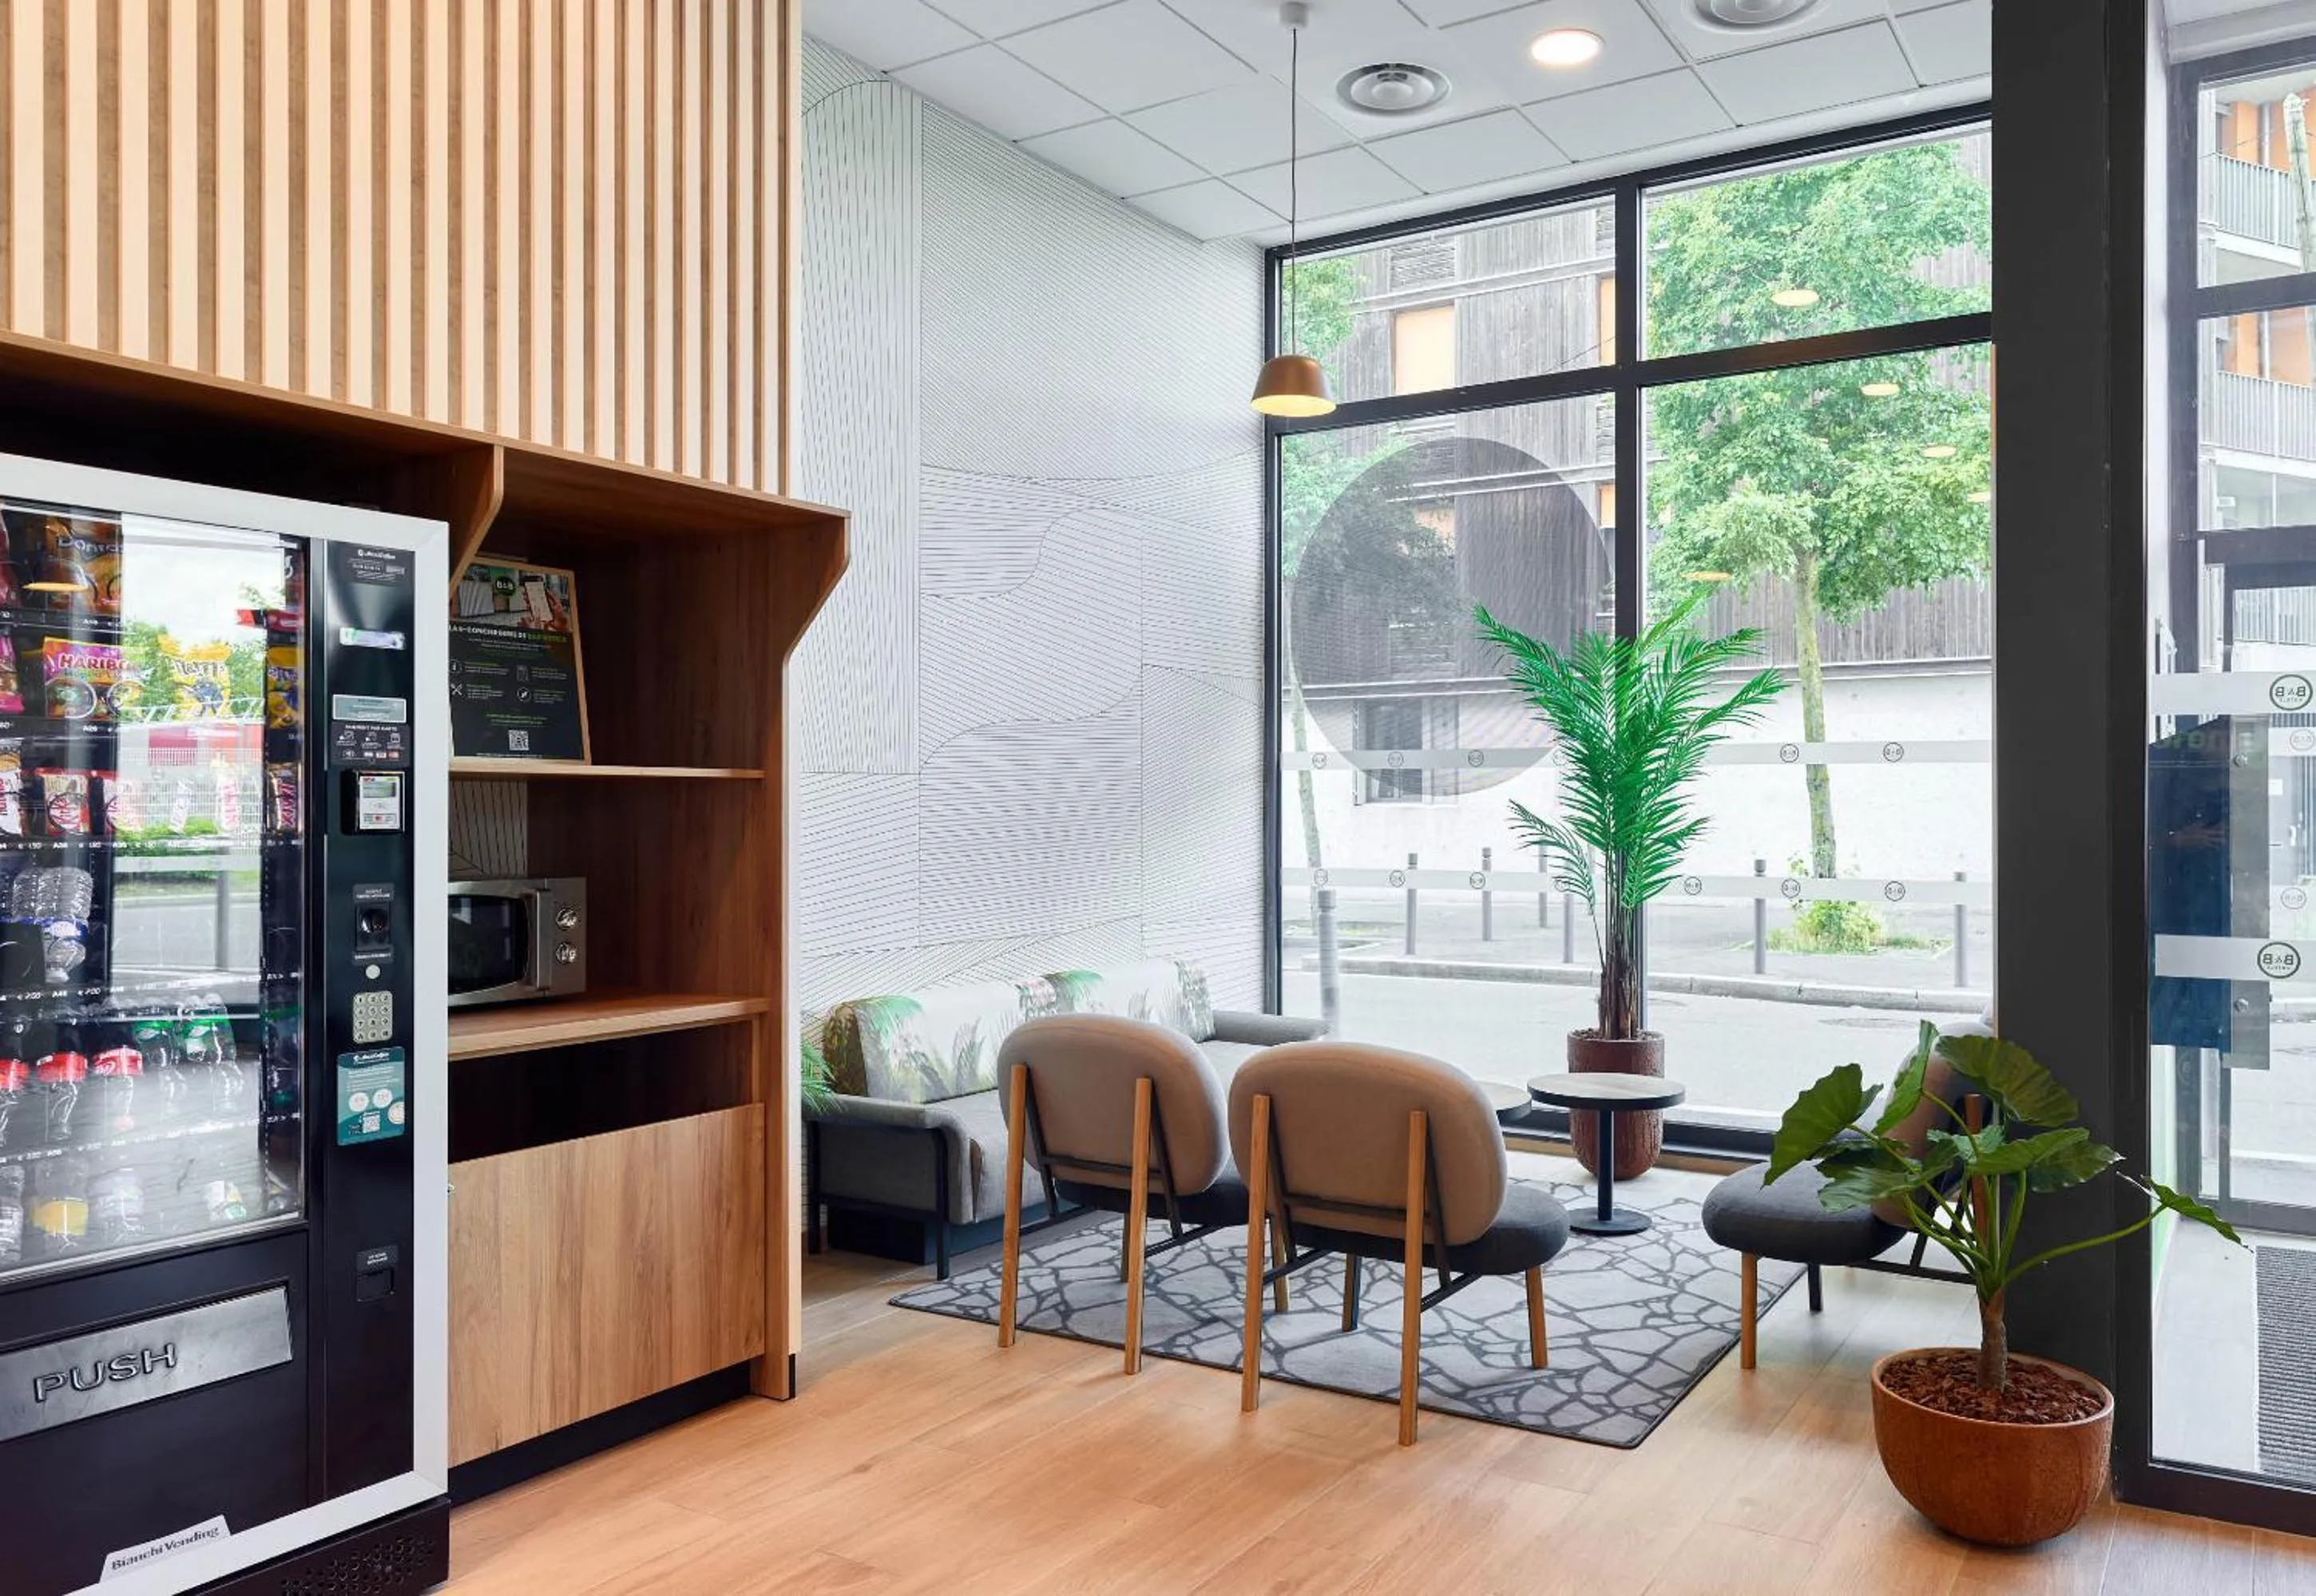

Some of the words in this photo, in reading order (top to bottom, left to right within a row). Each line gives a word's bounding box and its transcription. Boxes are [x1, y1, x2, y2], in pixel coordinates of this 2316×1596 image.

[34, 1342, 176, 1403] PUSH
[112, 1545, 163, 1570] Bianchi
[165, 1527, 220, 1550] Vending
